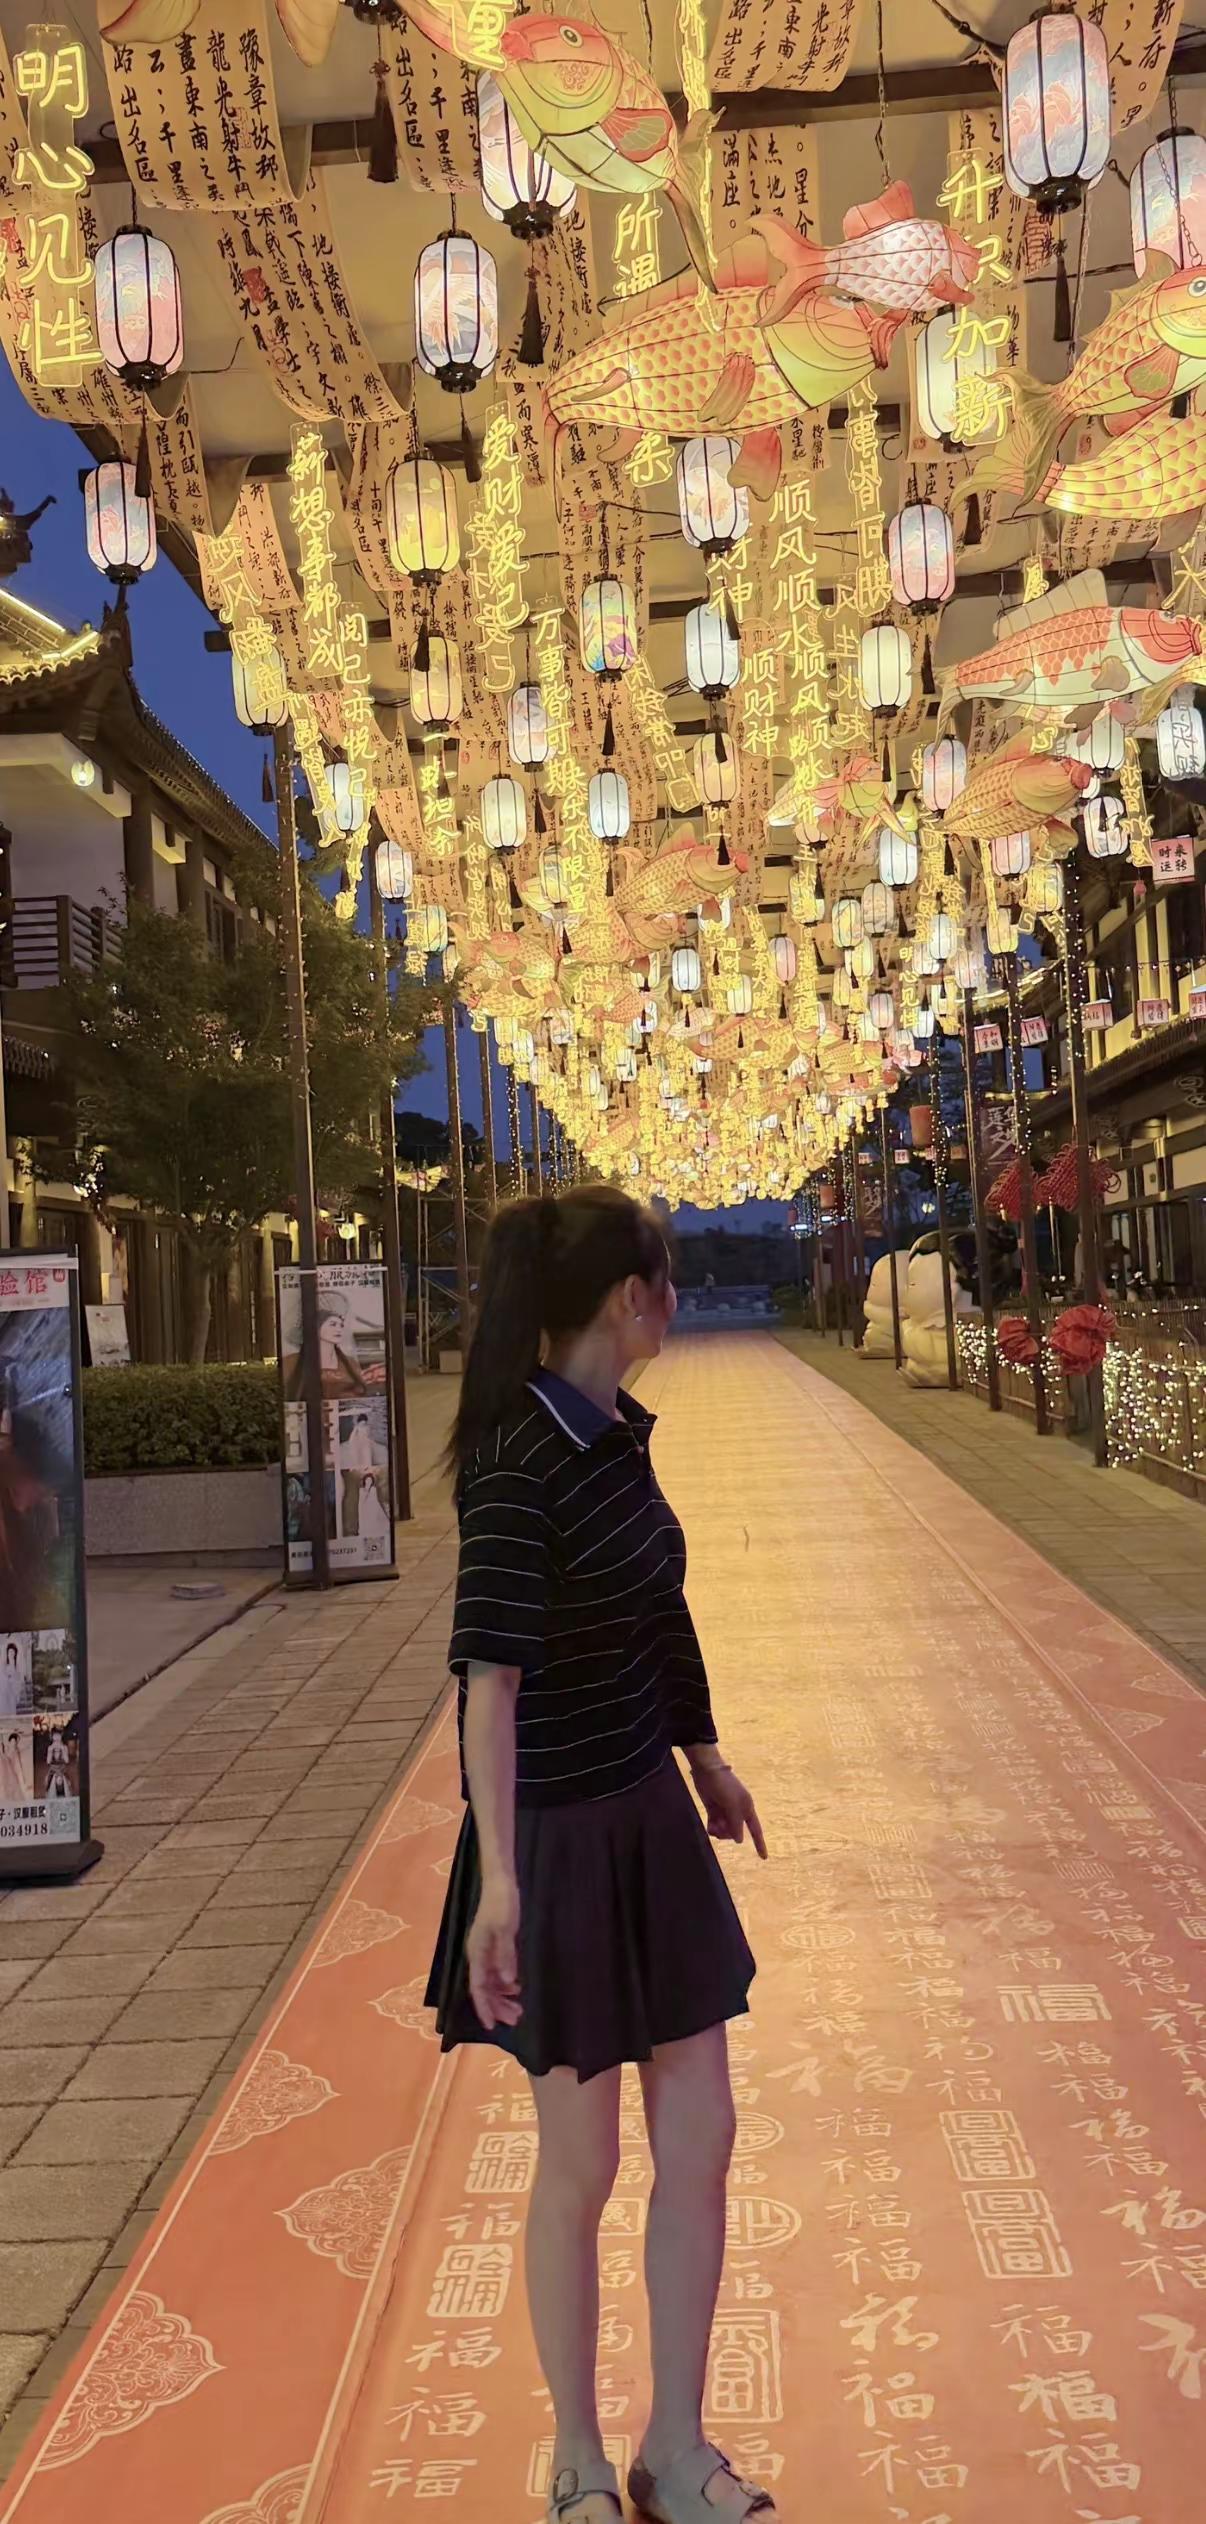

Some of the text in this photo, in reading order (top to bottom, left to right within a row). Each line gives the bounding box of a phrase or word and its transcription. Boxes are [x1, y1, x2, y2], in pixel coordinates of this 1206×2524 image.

[16, 44, 103, 373] 明心见性
[769, 480, 821, 653] 顺风顺水
[743, 647, 779, 757] 顺财神
[0, 1823, 48, 1838] 034918
[832, 2237, 923, 2285] 福
[406, 2326, 502, 2371] 福
[989, 2303, 1094, 2359] 福
[385, 2387, 488, 2441] 福
[369, 2457, 477, 2499] 福
[858, 2430, 969, 2495] 福
[1026, 2427, 1142, 2495] 福
